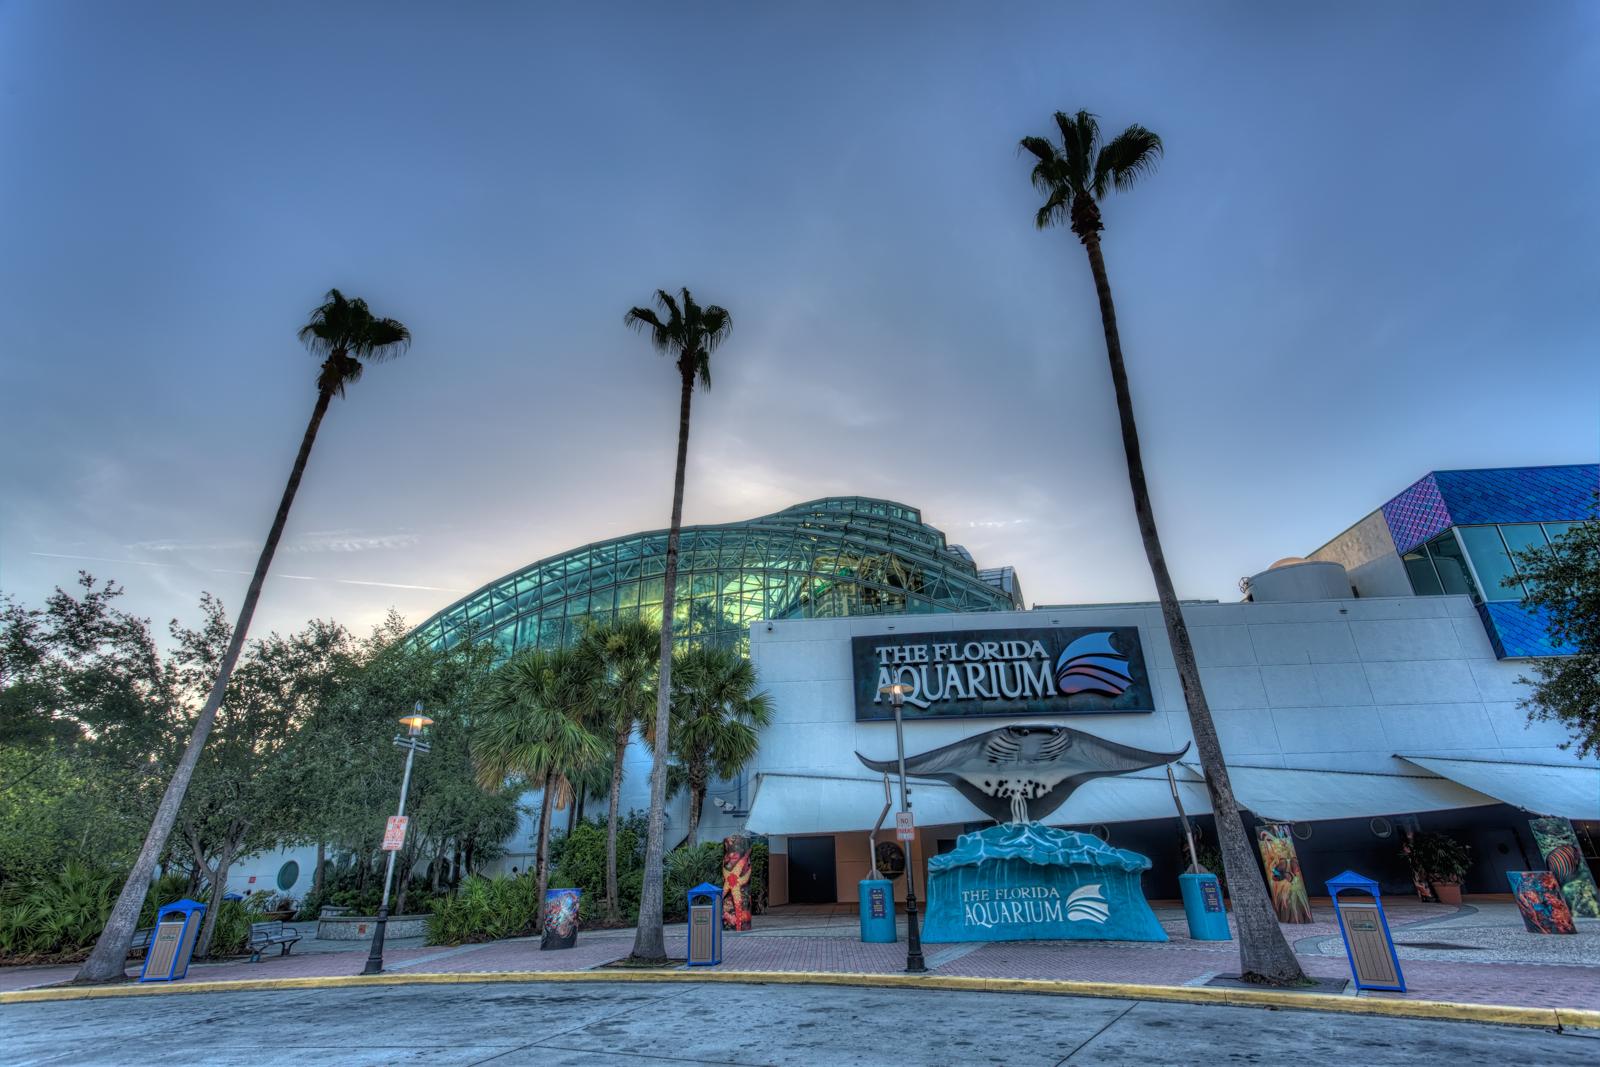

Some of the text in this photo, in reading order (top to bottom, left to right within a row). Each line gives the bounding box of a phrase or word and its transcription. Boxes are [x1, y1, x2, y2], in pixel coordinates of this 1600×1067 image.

[875, 640, 1049, 664] THE FLORIDA
[875, 661, 1058, 708] AQUARIUM
[962, 886, 1061, 902] THE FLORIDA
[964, 899, 1064, 928] AQUARIUM
